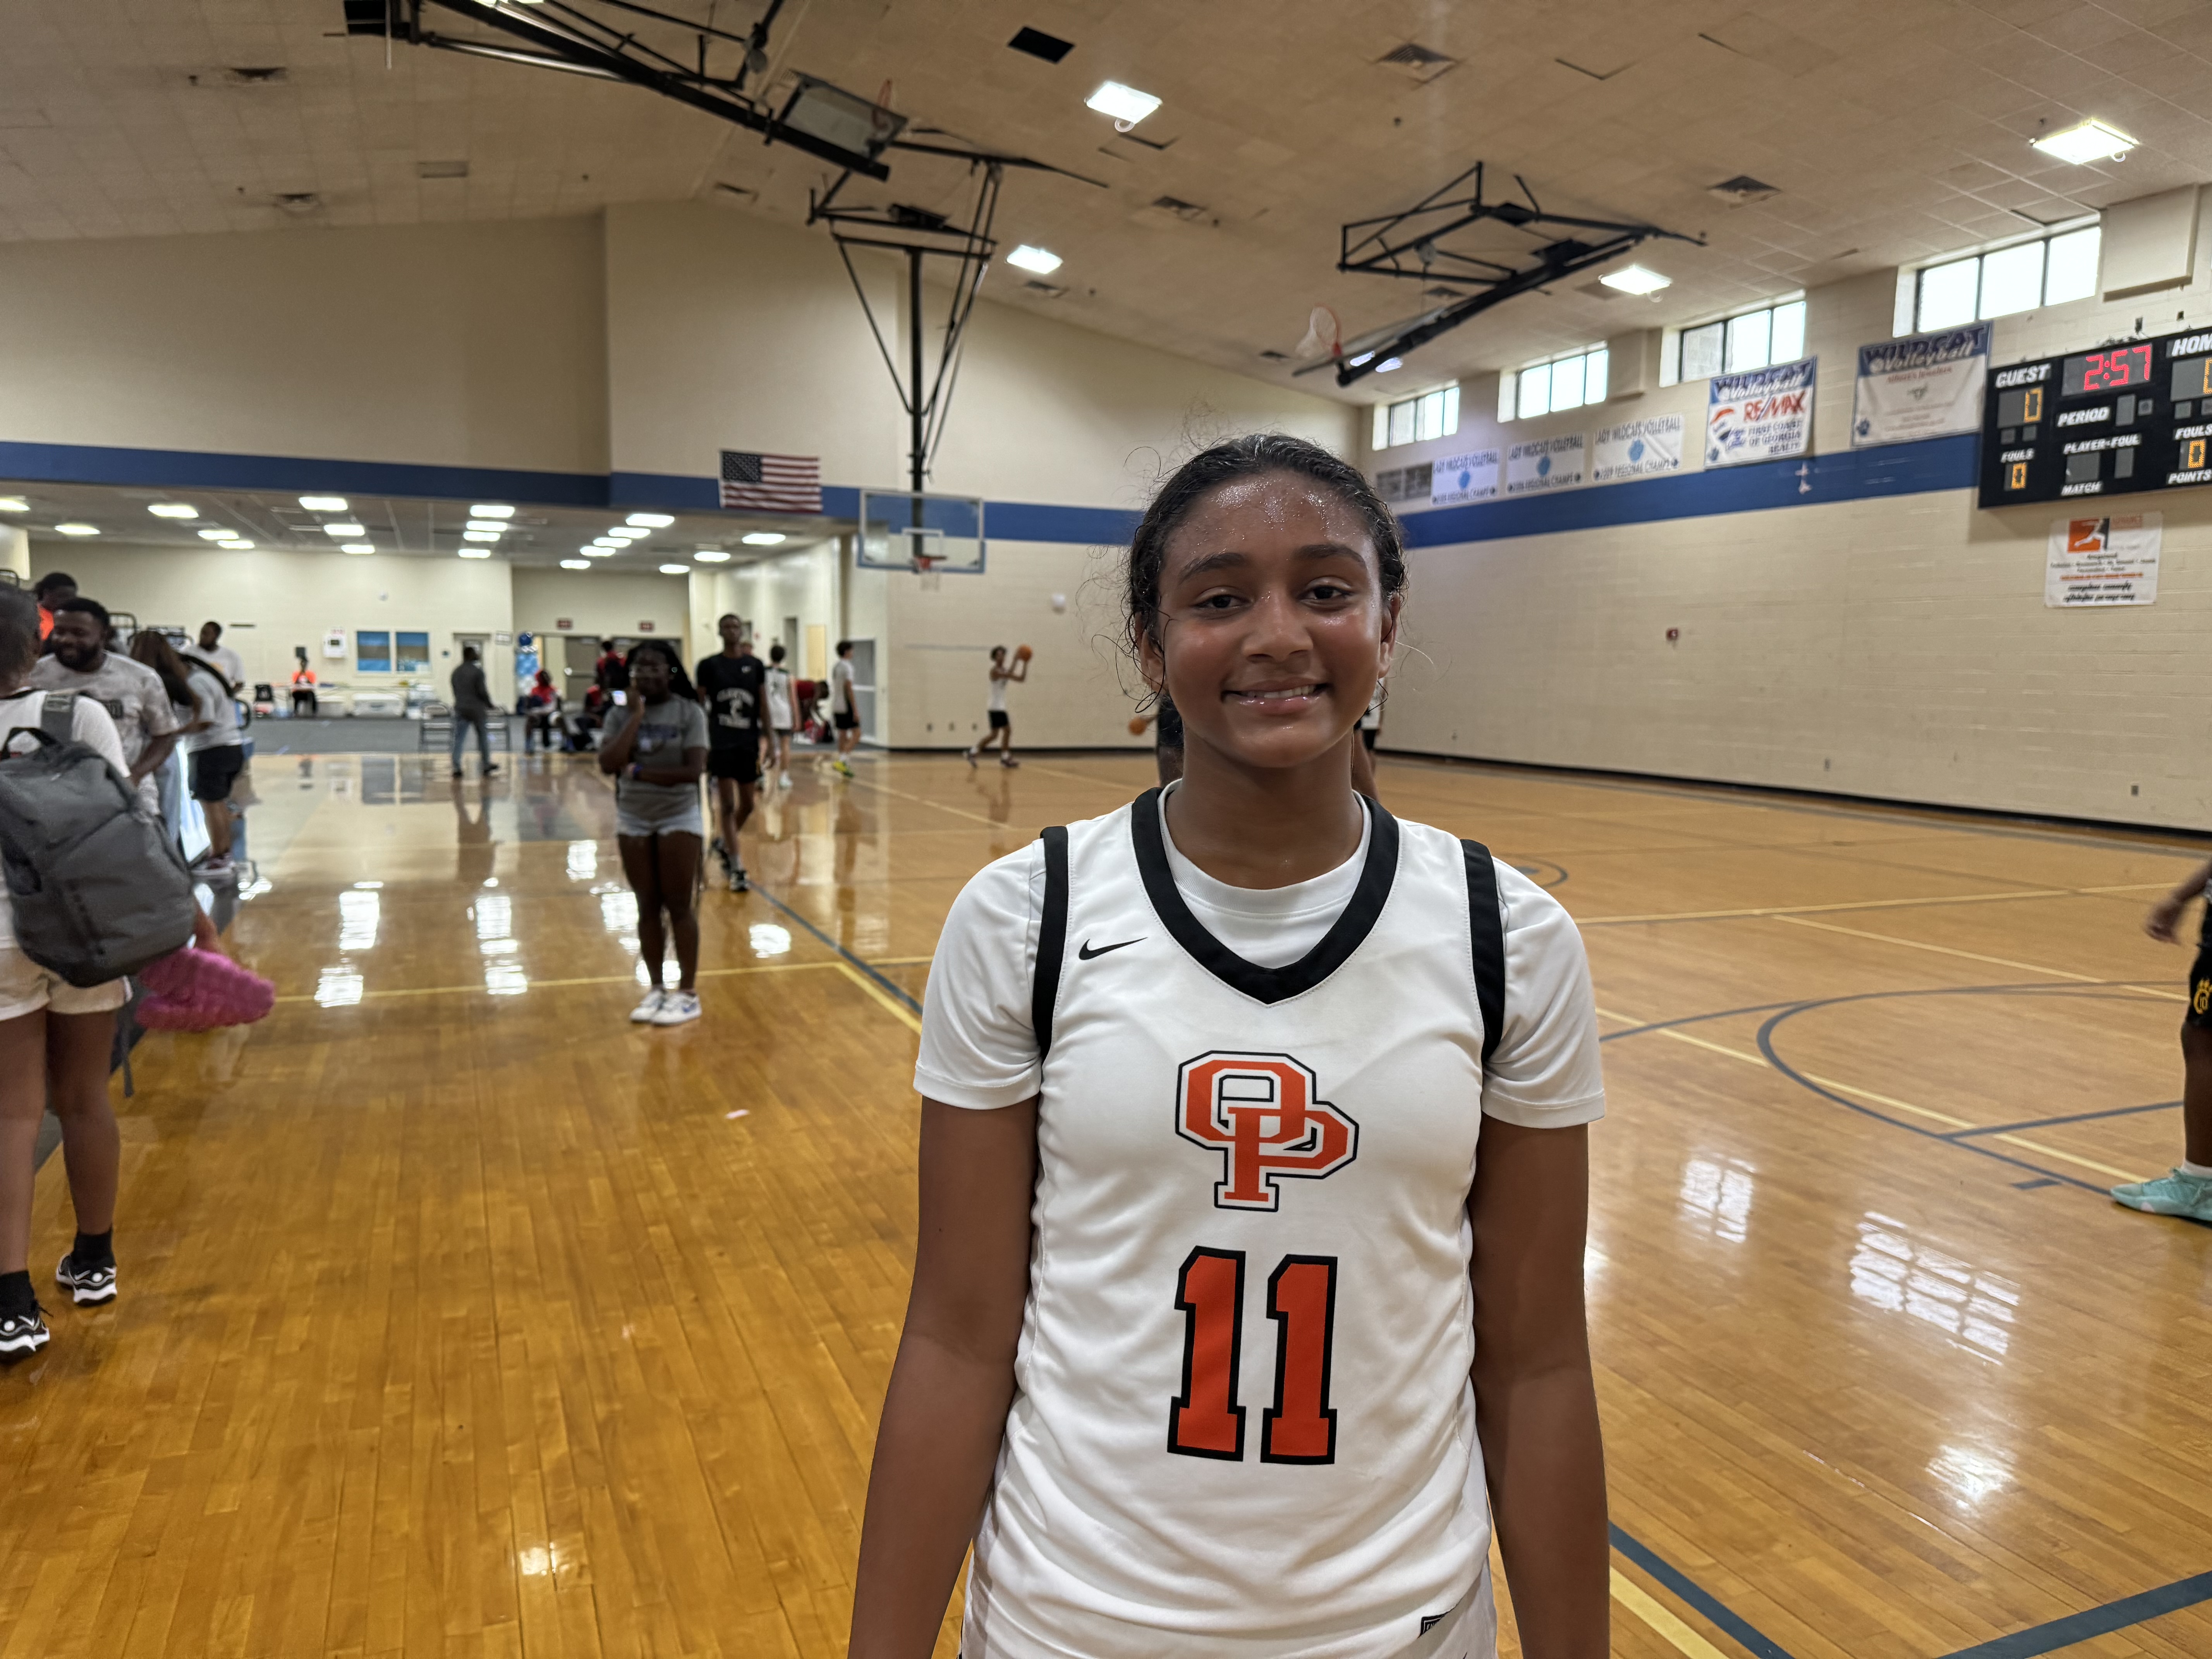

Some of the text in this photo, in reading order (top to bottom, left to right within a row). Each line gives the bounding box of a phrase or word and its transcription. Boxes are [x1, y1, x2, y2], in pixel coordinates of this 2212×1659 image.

[1863, 327, 1984, 363] WILDCAT
[1884, 341, 1974, 371] Volleyball
[1714, 361, 1811, 394] WILDCAT
[1996, 363, 2050, 387] GUEST
[2084, 344, 2151, 390] 2:57
[1744, 390, 1805, 422] RE/MAX
[2024, 387, 2042, 422] 0
[2057, 407, 2110, 427] PERIOD
[2063, 434, 2140, 454] PLAYER-FOUL
[2175, 425, 2212, 440] FOULS
[2001, 449, 2034, 463] FOULS
[2188, 440, 2205, 468] 0
[2011, 462, 2027, 489] 0
[2169, 469, 2212, 484] POINTS
[2061, 483, 2101, 496] MATCH
[1168, 1246, 1338, 1465] 11
